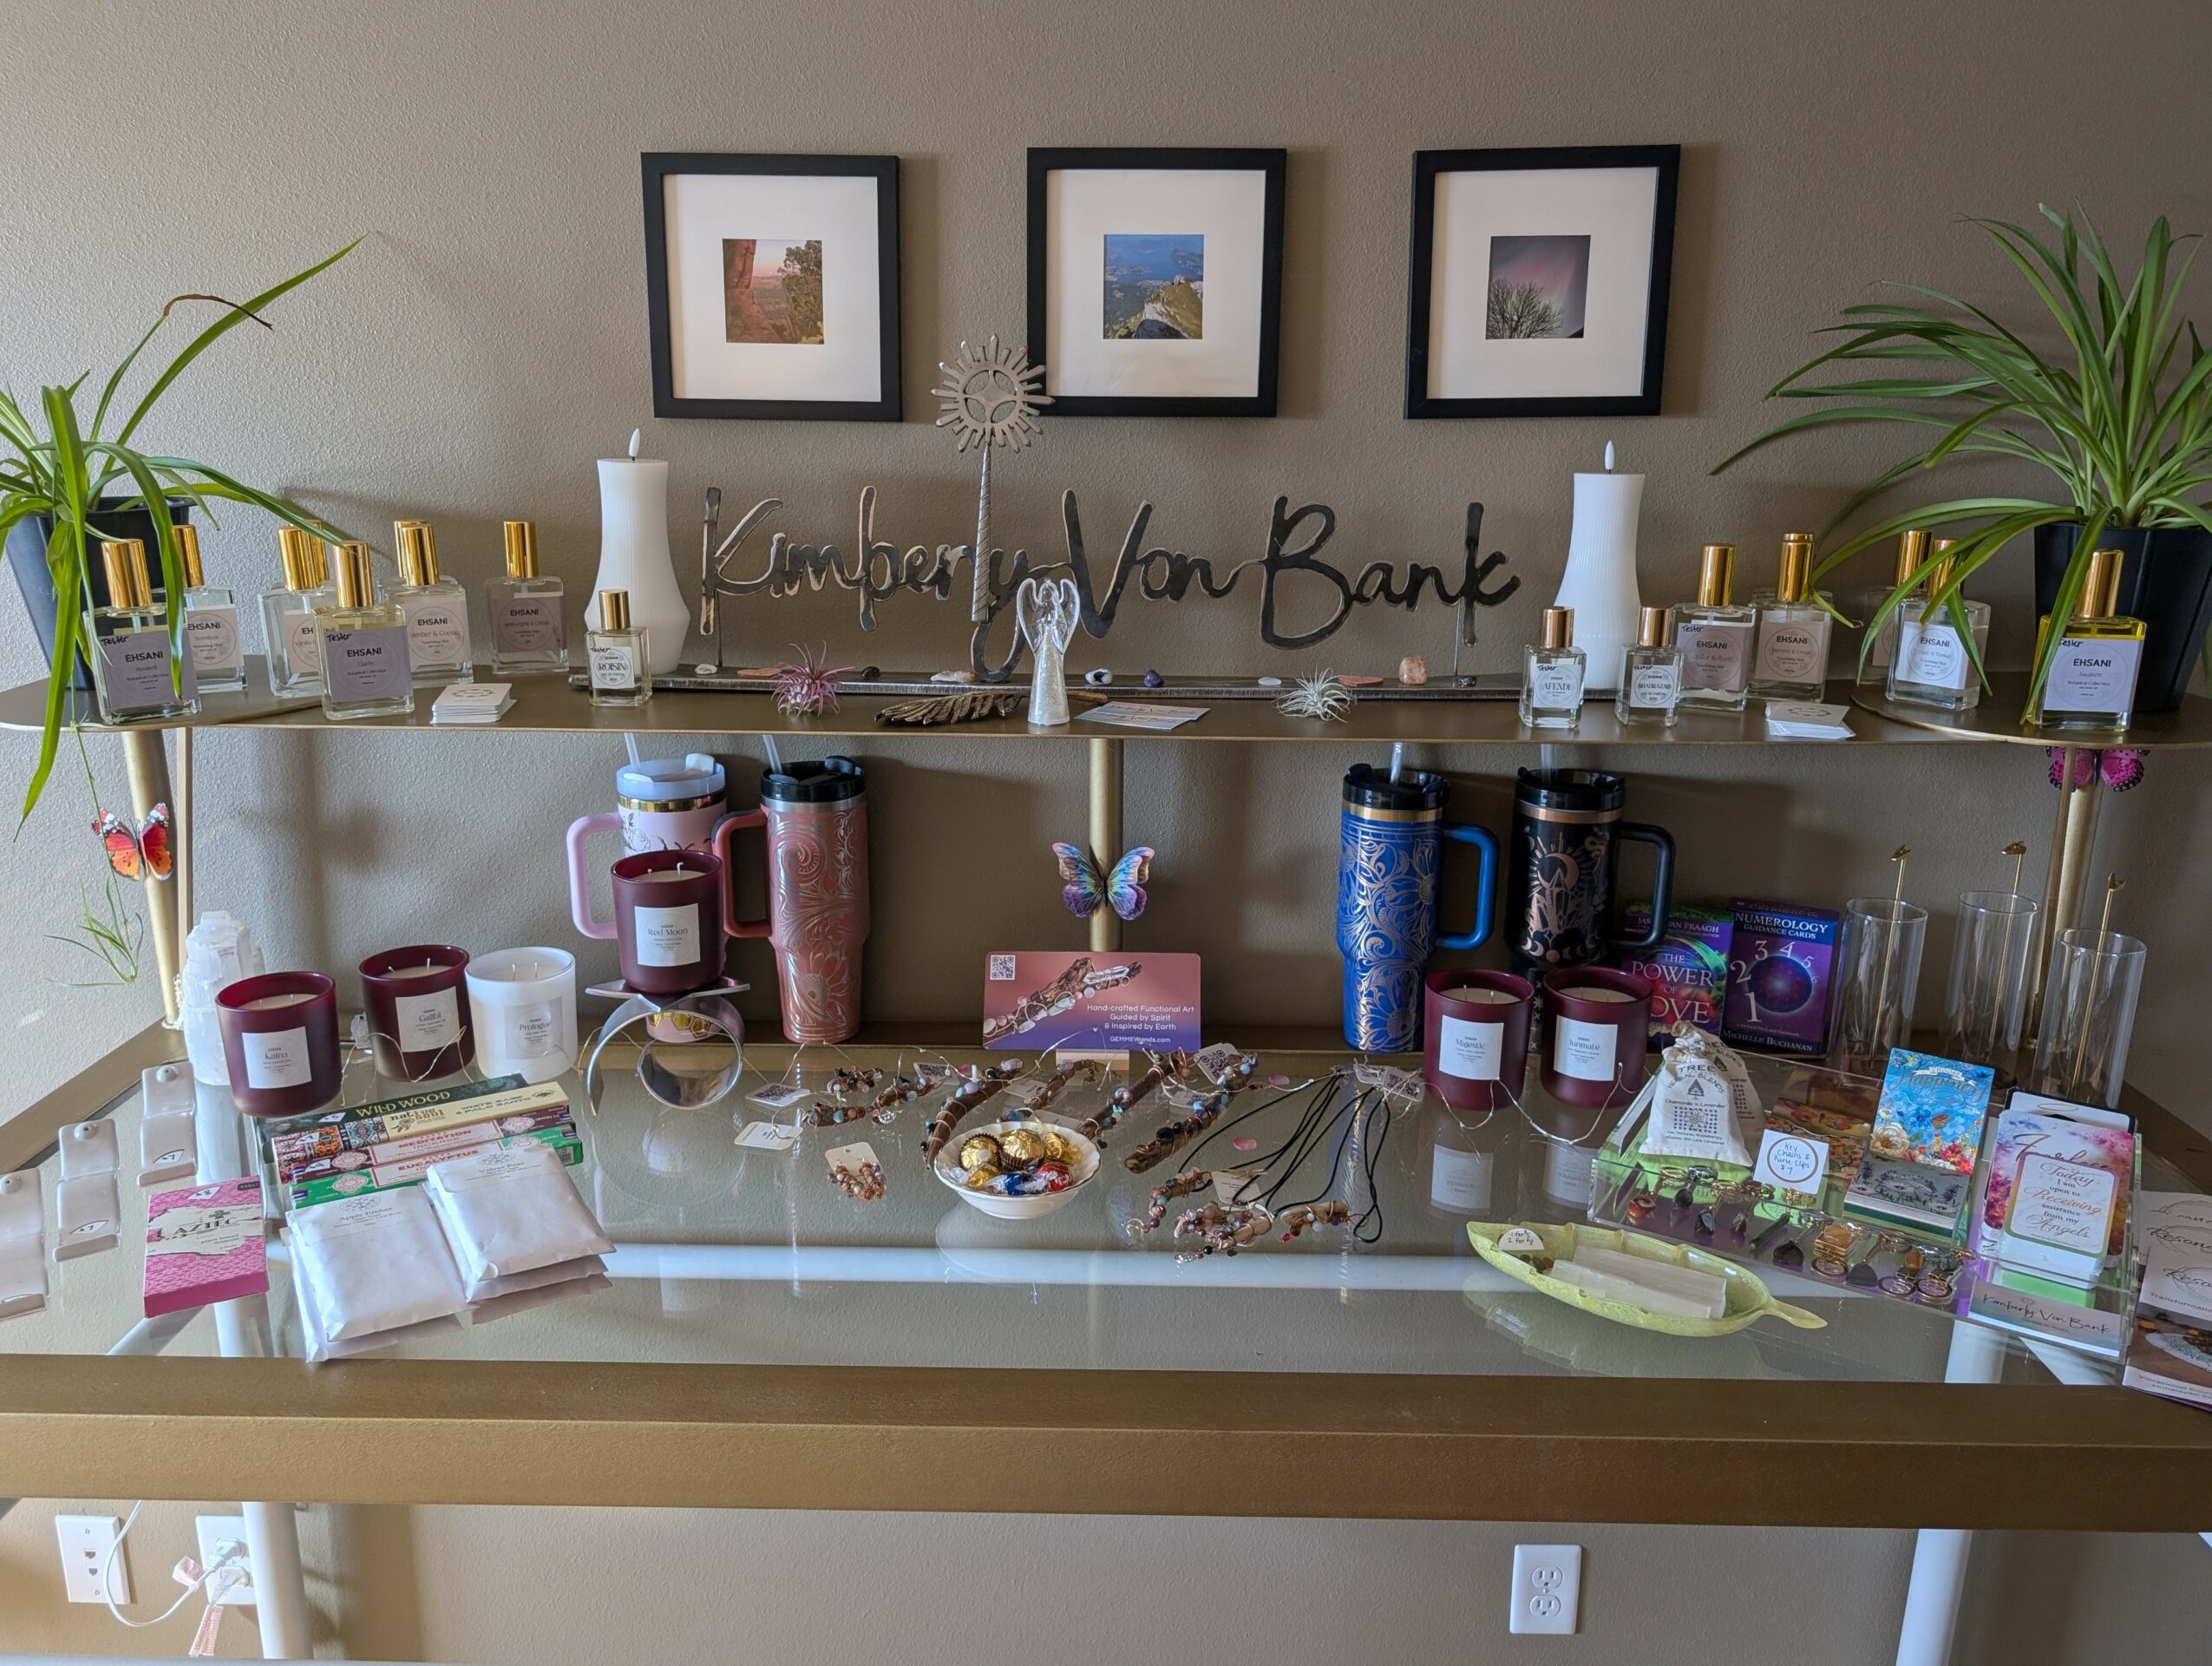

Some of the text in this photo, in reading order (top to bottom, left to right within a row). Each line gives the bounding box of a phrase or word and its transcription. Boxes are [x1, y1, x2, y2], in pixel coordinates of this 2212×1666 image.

[1260, 494, 1522, 651] Bank
[510, 608, 540, 617] EHSANI
[187, 621, 221, 631] EHSANI
[417, 617, 448, 626] EHSANI
[1681, 624, 1705, 633] Tester
[101, 635, 129, 646] Tester
[326, 632, 353, 643] Tester
[1777, 635, 1808, 645] EHSANI
[1921, 637, 1950, 648] EHSANI
[1696, 640, 1727, 650] EHSANI
[125, 651, 164, 663] EHSANI
[347, 647, 383, 658] EHSANI
[599, 662, 626, 672] ROISIN
[2072, 658, 2112, 668] EHSANI
[1542, 682, 1571, 692] AFENDI
[1684, 922, 1719, 934] PRAAGH
[1735, 912, 1829, 934] NUMEROLOGY
[647, 928, 688, 936] Red Moon
[1744, 923, 1816, 940] GUIDANCE CARDS
[1754, 940, 1769, 961] 3
[1779, 941, 1796, 958] 4
[1665, 954, 1685, 963] THE
[1801, 955, 1815, 968] 5
[1632, 961, 1715, 987] POWER
[1730, 960, 1751, 984] 2
[1663, 985, 1679, 994] OF
[1087, 1004, 1139, 1013] Hand-crafted
[1140, 1004, 1181, 1013] Functional
[1651, 995, 1711, 1024] OVE
[1744, 991, 1762, 1022] 1
[1140, 1013, 1149, 1022] by
[1150, 1013, 1171, 1022] Spirit
[1111, 1022, 1143, 1031] Inspired
[1144, 1023, 1154, 1032] by
[1456, 1038, 1486, 1049] Majestic
[1723, 1029, 1813, 1052] MICHELLE BUCHANAN
[1679, 1064, 1716, 1073] TREE
[356, 1091, 451, 1118] WILD WOOD
[461, 1101, 494, 1111] WHITE
[464, 1105, 494, 1114] PALO
[495, 1097, 532, 1107] SANTO
[1699, 1100, 1725, 1109] Lavender
[399, 1130, 472, 1149] MEDITATION
[1784, 1141, 1798, 1152] Key
[1777, 1149, 1802, 1159] Chains
[397, 1150, 479, 1171] EUCALYPTUS
[1773, 1155, 1810, 1171] Purse Clips
[2040, 1162, 2096, 1188] Today
[2049, 1185, 2071, 1197] open
[2062, 1181, 2077, 1190] am
[2024, 1186, 2103, 1216] Receiving
[2041, 1203, 2081, 1217] assistance
[339, 1213, 363, 1222] Apple
[2043, 1210, 2080, 1225] from my
[173, 1217, 238, 1236] AZTEC
[2025, 1214, 2091, 1239] Angels
[1983, 1294, 2036, 1319] Kimberly
[2069, 1316, 2111, 1334] Bank
